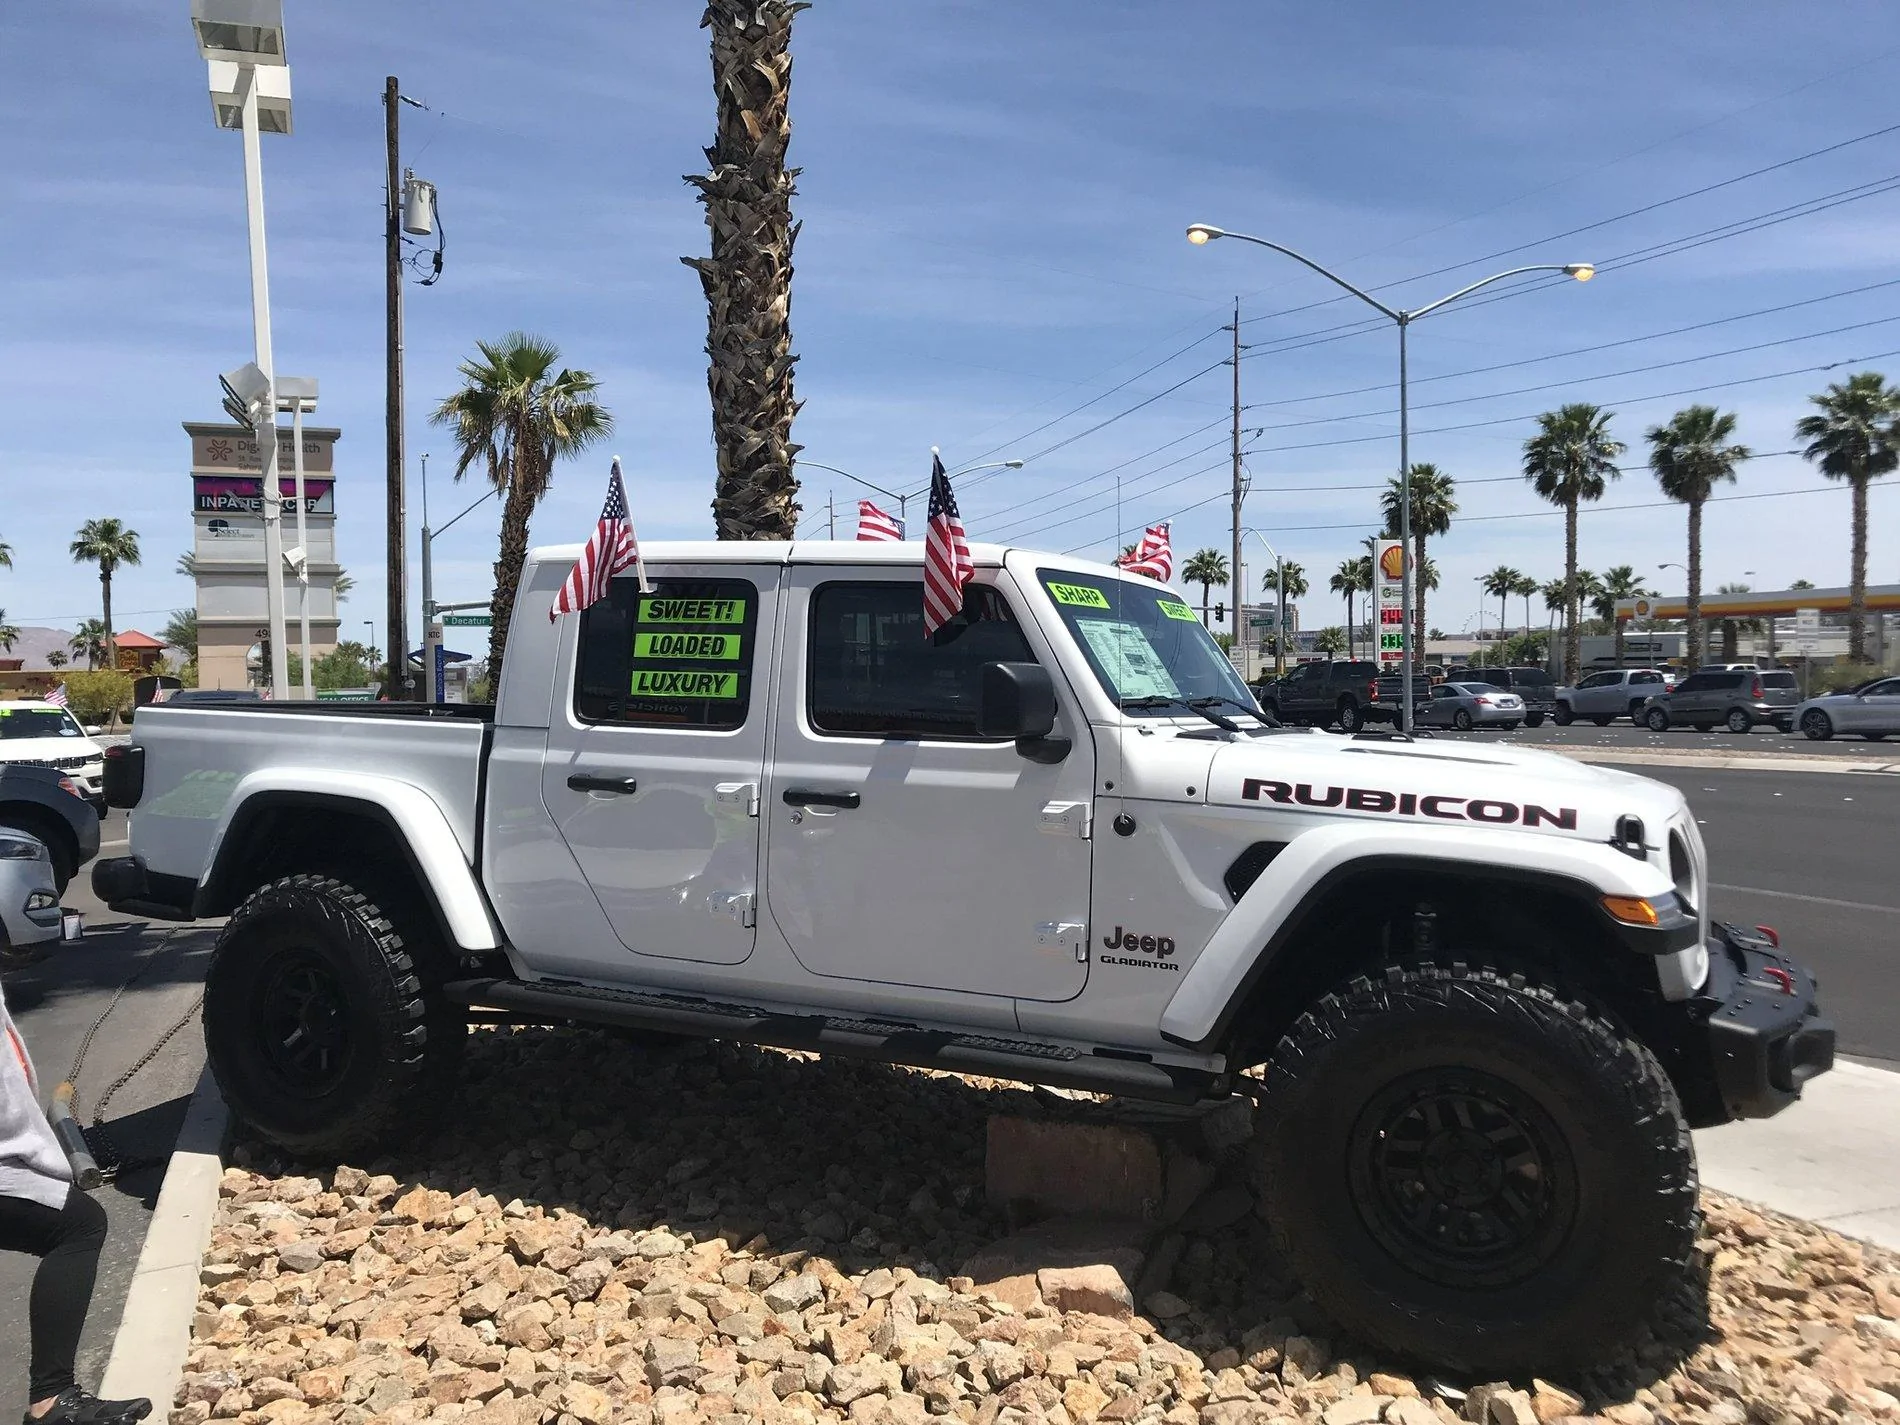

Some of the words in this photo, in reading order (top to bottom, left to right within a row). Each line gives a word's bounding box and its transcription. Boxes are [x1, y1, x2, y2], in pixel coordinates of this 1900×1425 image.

[1055, 584, 1100, 605] SHARP
[451, 617, 487, 625] Decatur
[648, 600, 736, 621] SWEET!
[254, 628, 271, 639] 49
[648, 635, 728, 657] LOADED
[637, 672, 731, 695] LUXURY
[1241, 777, 1577, 830] RUBICON
[1103, 926, 1175, 959] Jeep
[1100, 955, 1179, 972] GLADIATOR
